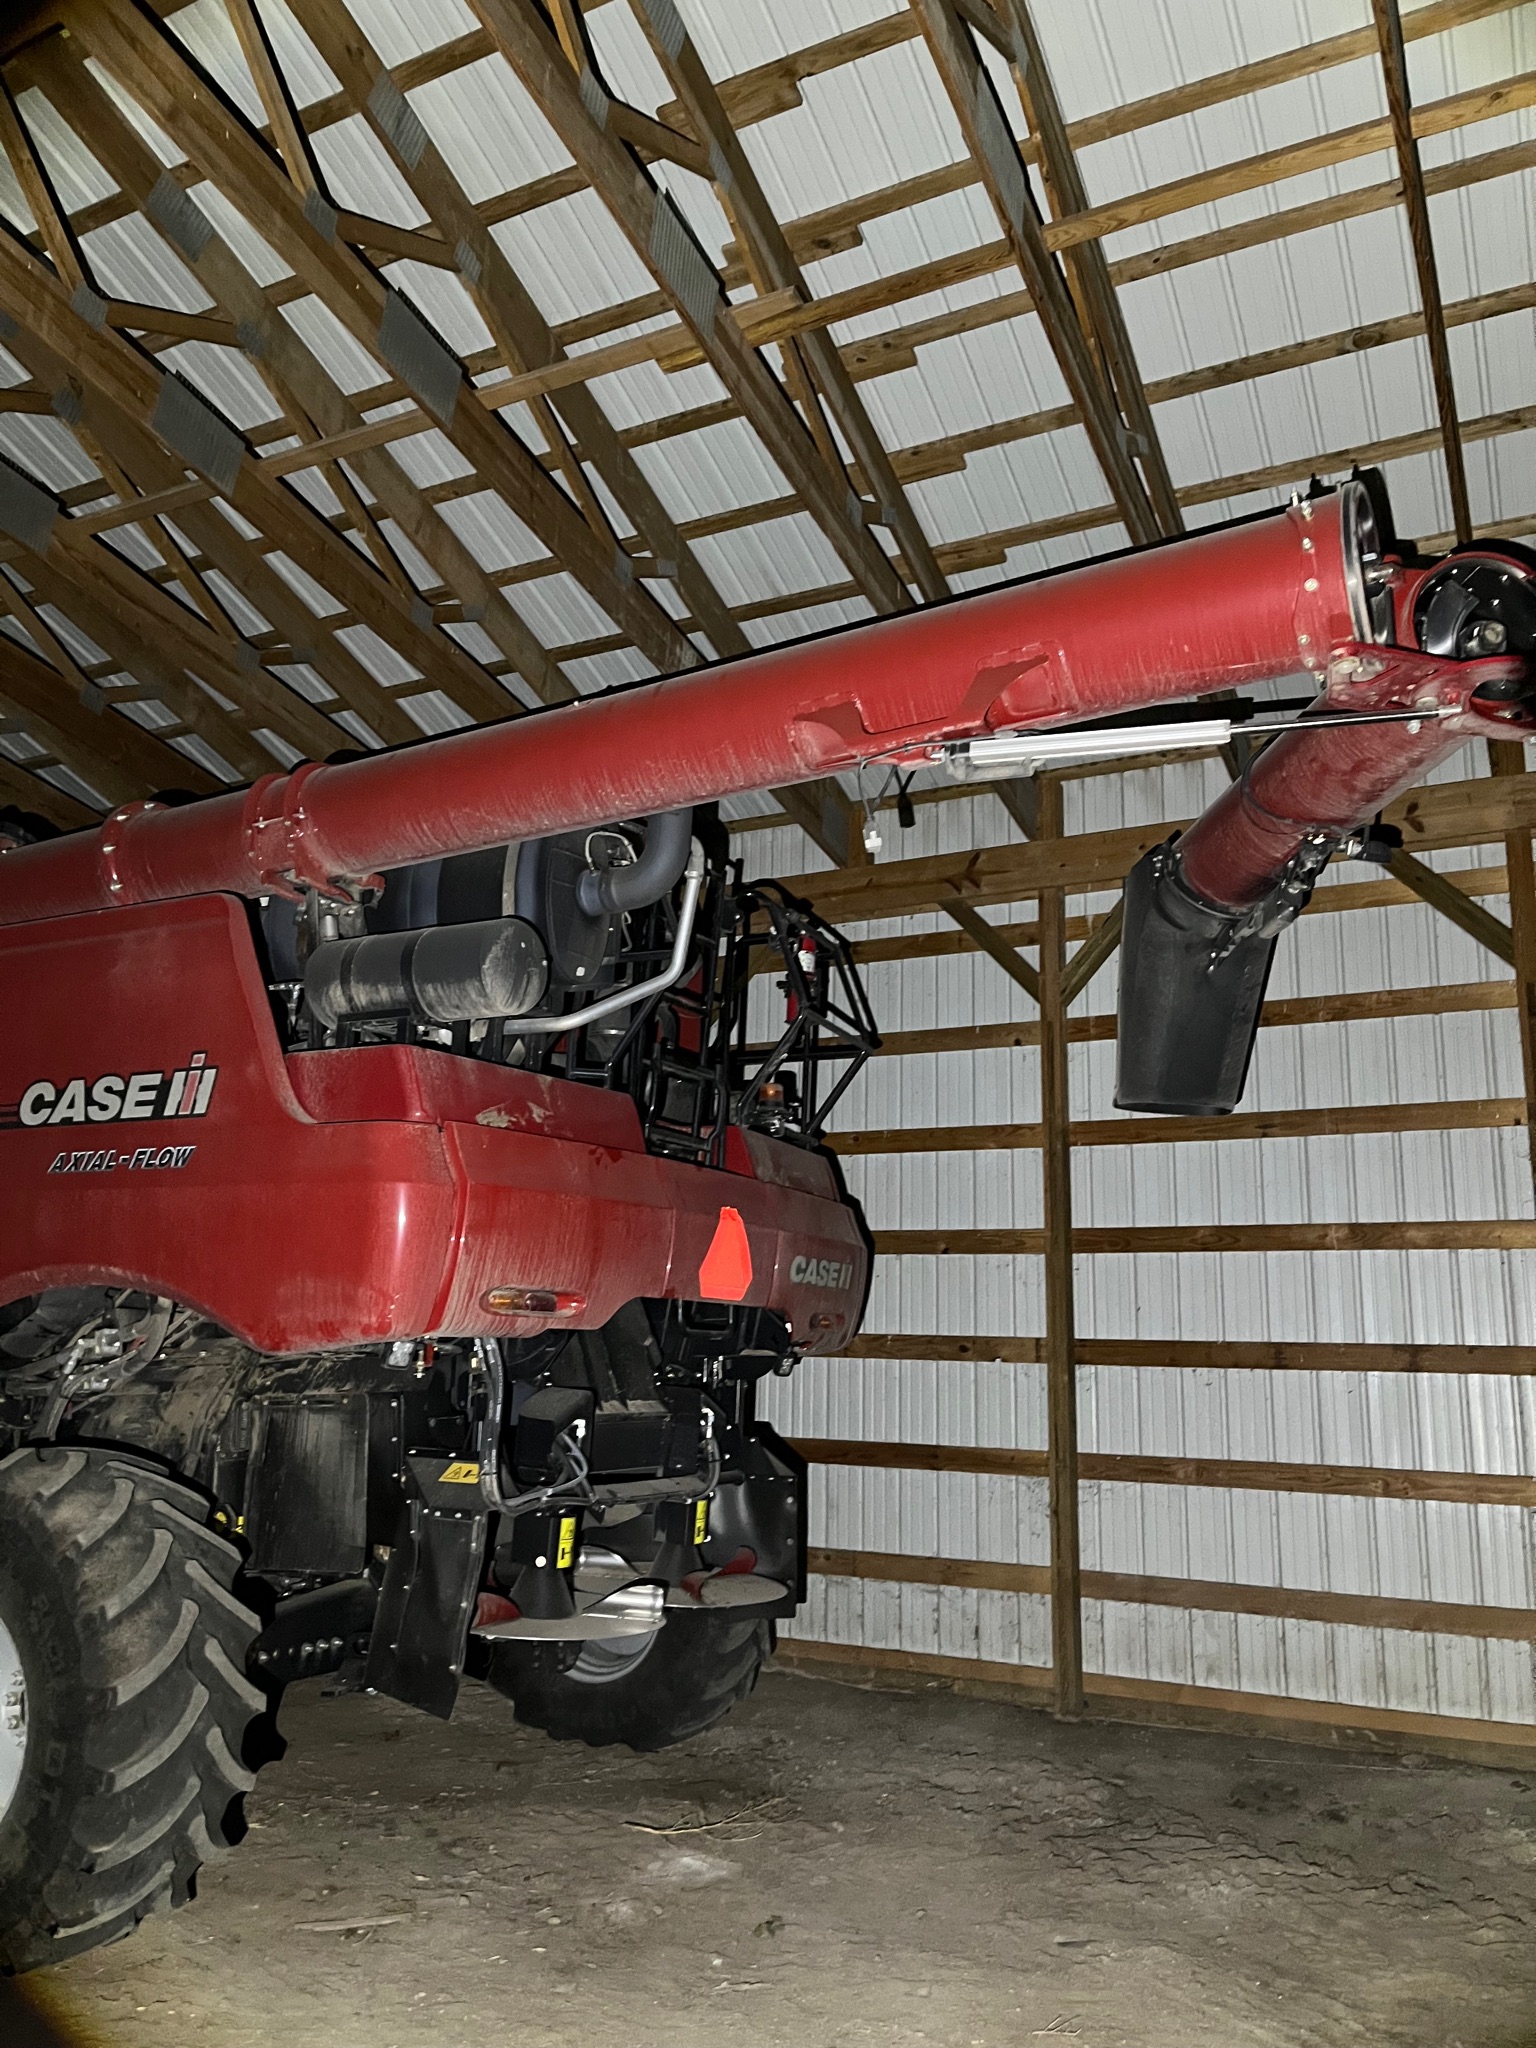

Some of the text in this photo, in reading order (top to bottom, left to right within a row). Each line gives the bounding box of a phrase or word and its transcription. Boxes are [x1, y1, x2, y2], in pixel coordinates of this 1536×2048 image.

[19, 1073, 163, 1126] CASE
[47, 1145, 196, 1174] AXIAL-FLOW
[790, 1255, 840, 1288] CASE
